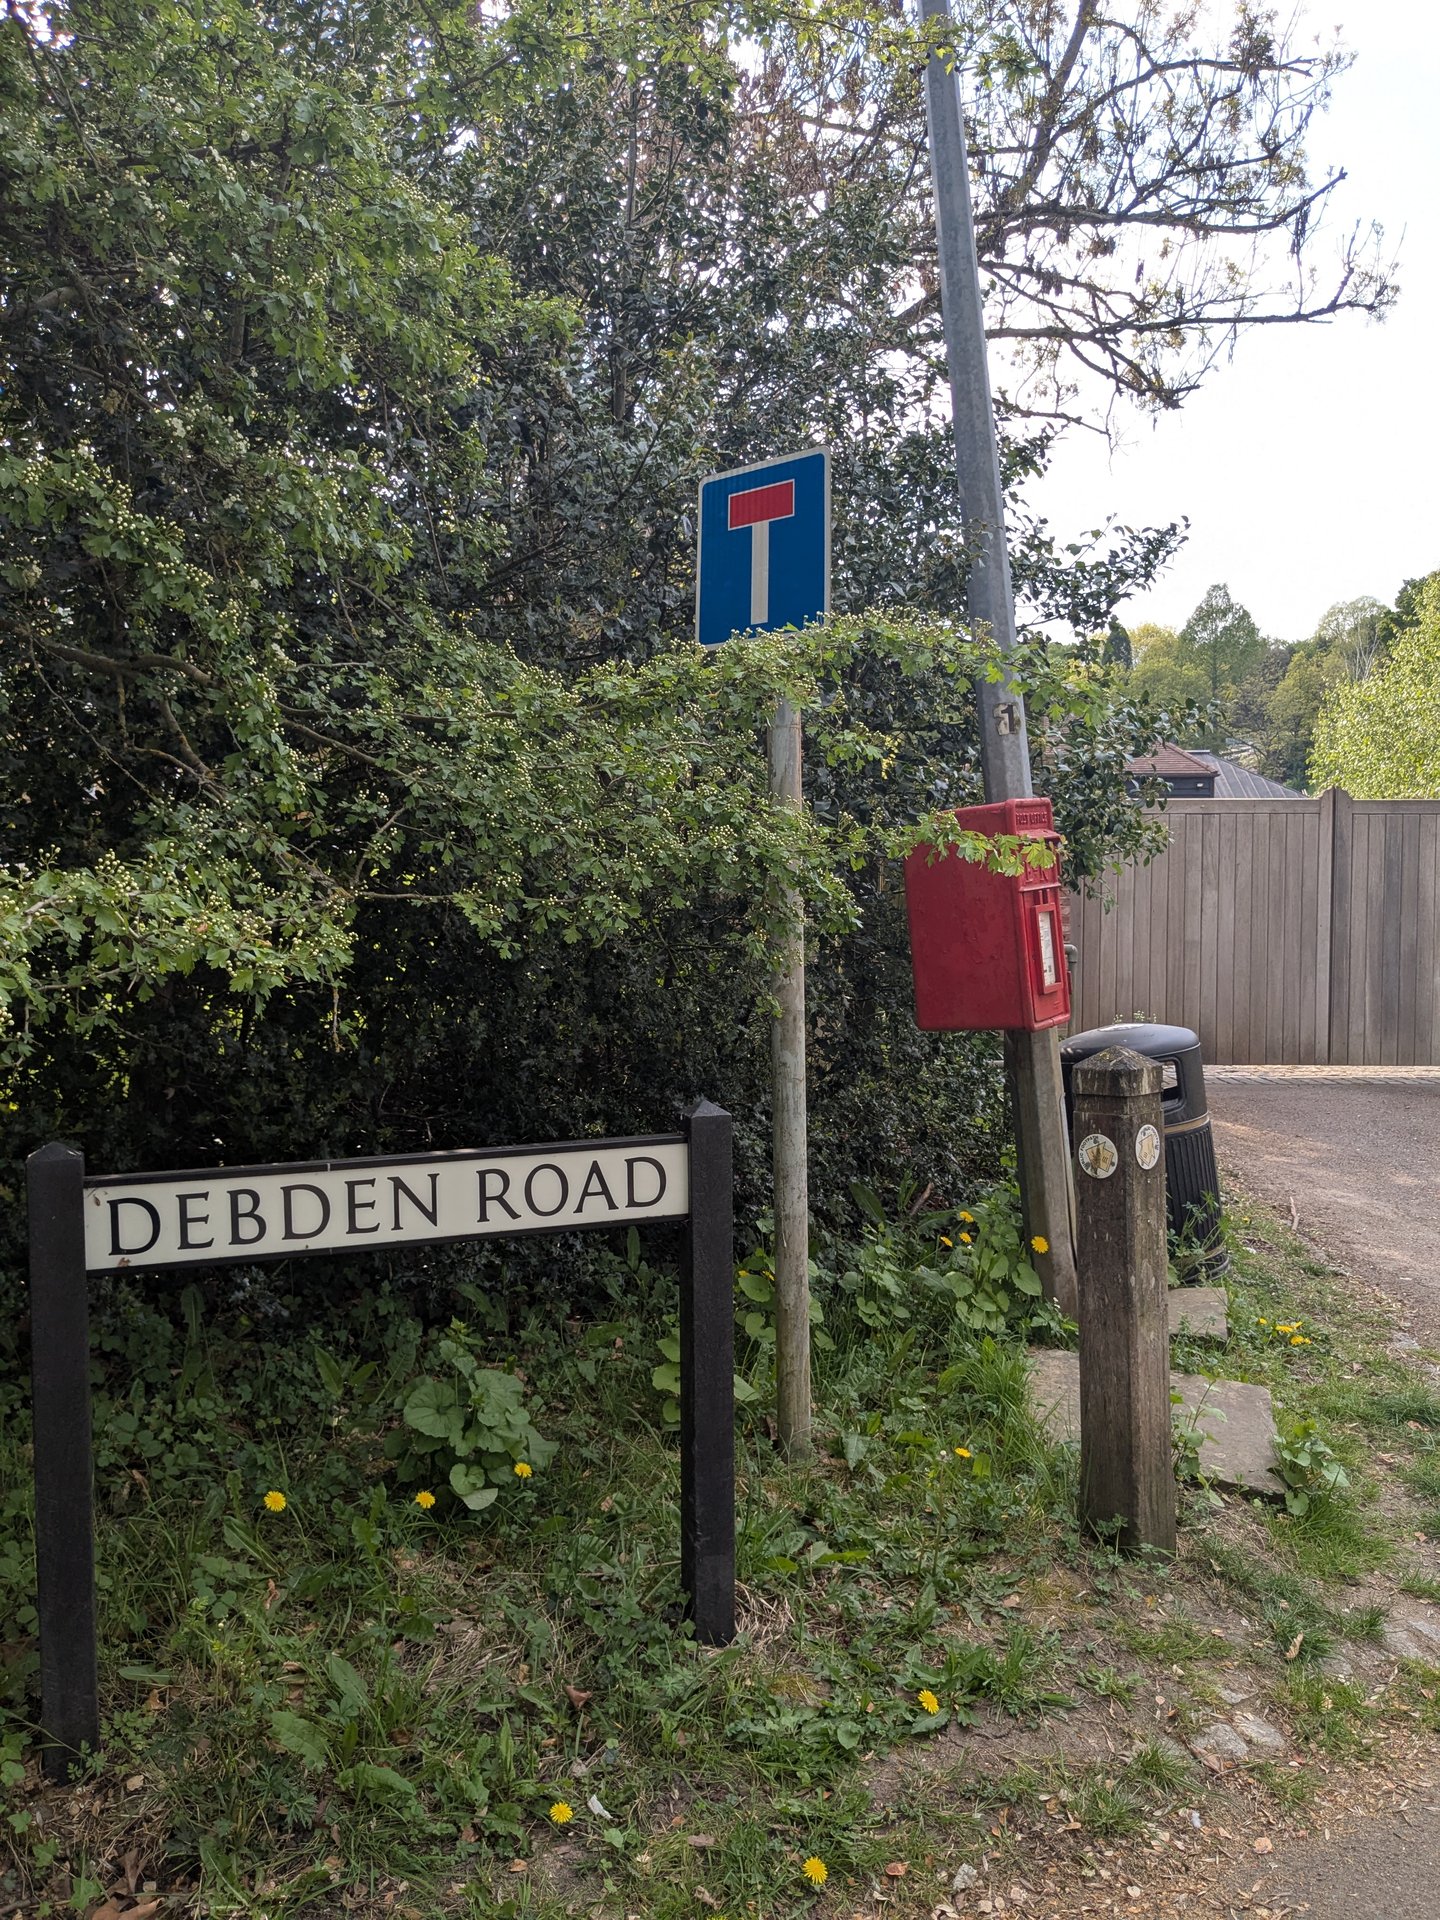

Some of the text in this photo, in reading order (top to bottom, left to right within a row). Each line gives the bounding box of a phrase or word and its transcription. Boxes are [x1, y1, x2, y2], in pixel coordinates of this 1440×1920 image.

[1080, 1136, 1099, 1151] FOOTPATH
[107, 1157, 667, 1256] DEBDEN ROAD
